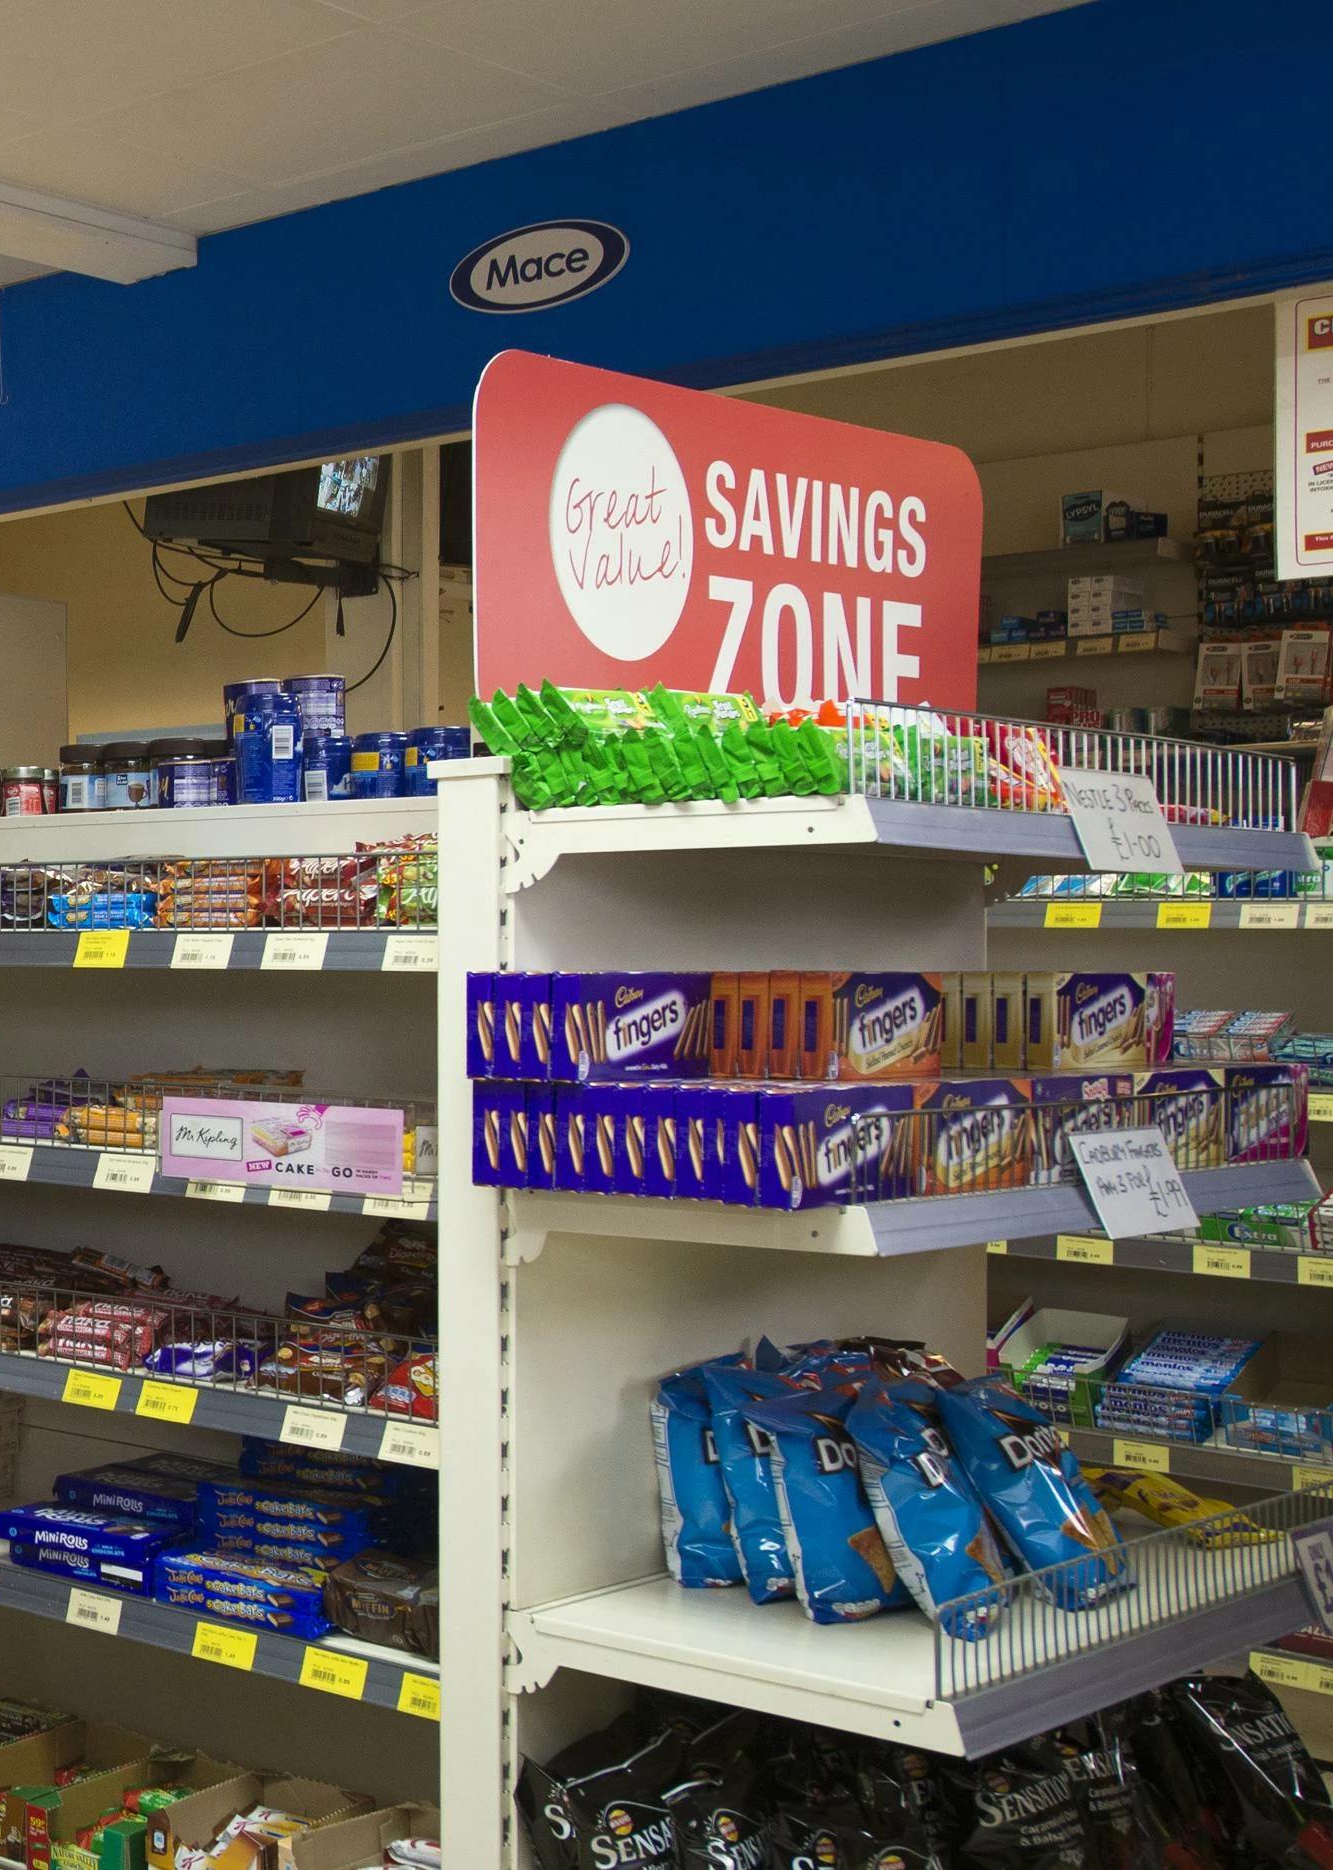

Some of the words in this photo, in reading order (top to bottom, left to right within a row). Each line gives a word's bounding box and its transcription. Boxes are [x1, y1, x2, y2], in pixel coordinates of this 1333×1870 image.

[485, 245, 589, 290] Mace
[565, 465, 667, 536] Great
[704, 460, 927, 579] SAVINGS
[568, 512, 687, 590] Value!
[707, 574, 924, 703] ZONE
[1063, 781, 1115, 811] NESTLE
[615, 985, 645, 1010] Cadbury
[858, 995, 918, 1050] fingers
[1077, 993, 1128, 1044] fingers
[613, 999, 680, 1053] fingers
[196, 1127, 239, 1150] Kipling
[248, 1161, 271, 1171] NEW
[274, 1162, 316, 1176] CAKE
[331, 1166, 353, 1179] GO
[1140, 1360, 1195, 1372] mentos
[974, 1772, 1072, 1829] SENSATION
